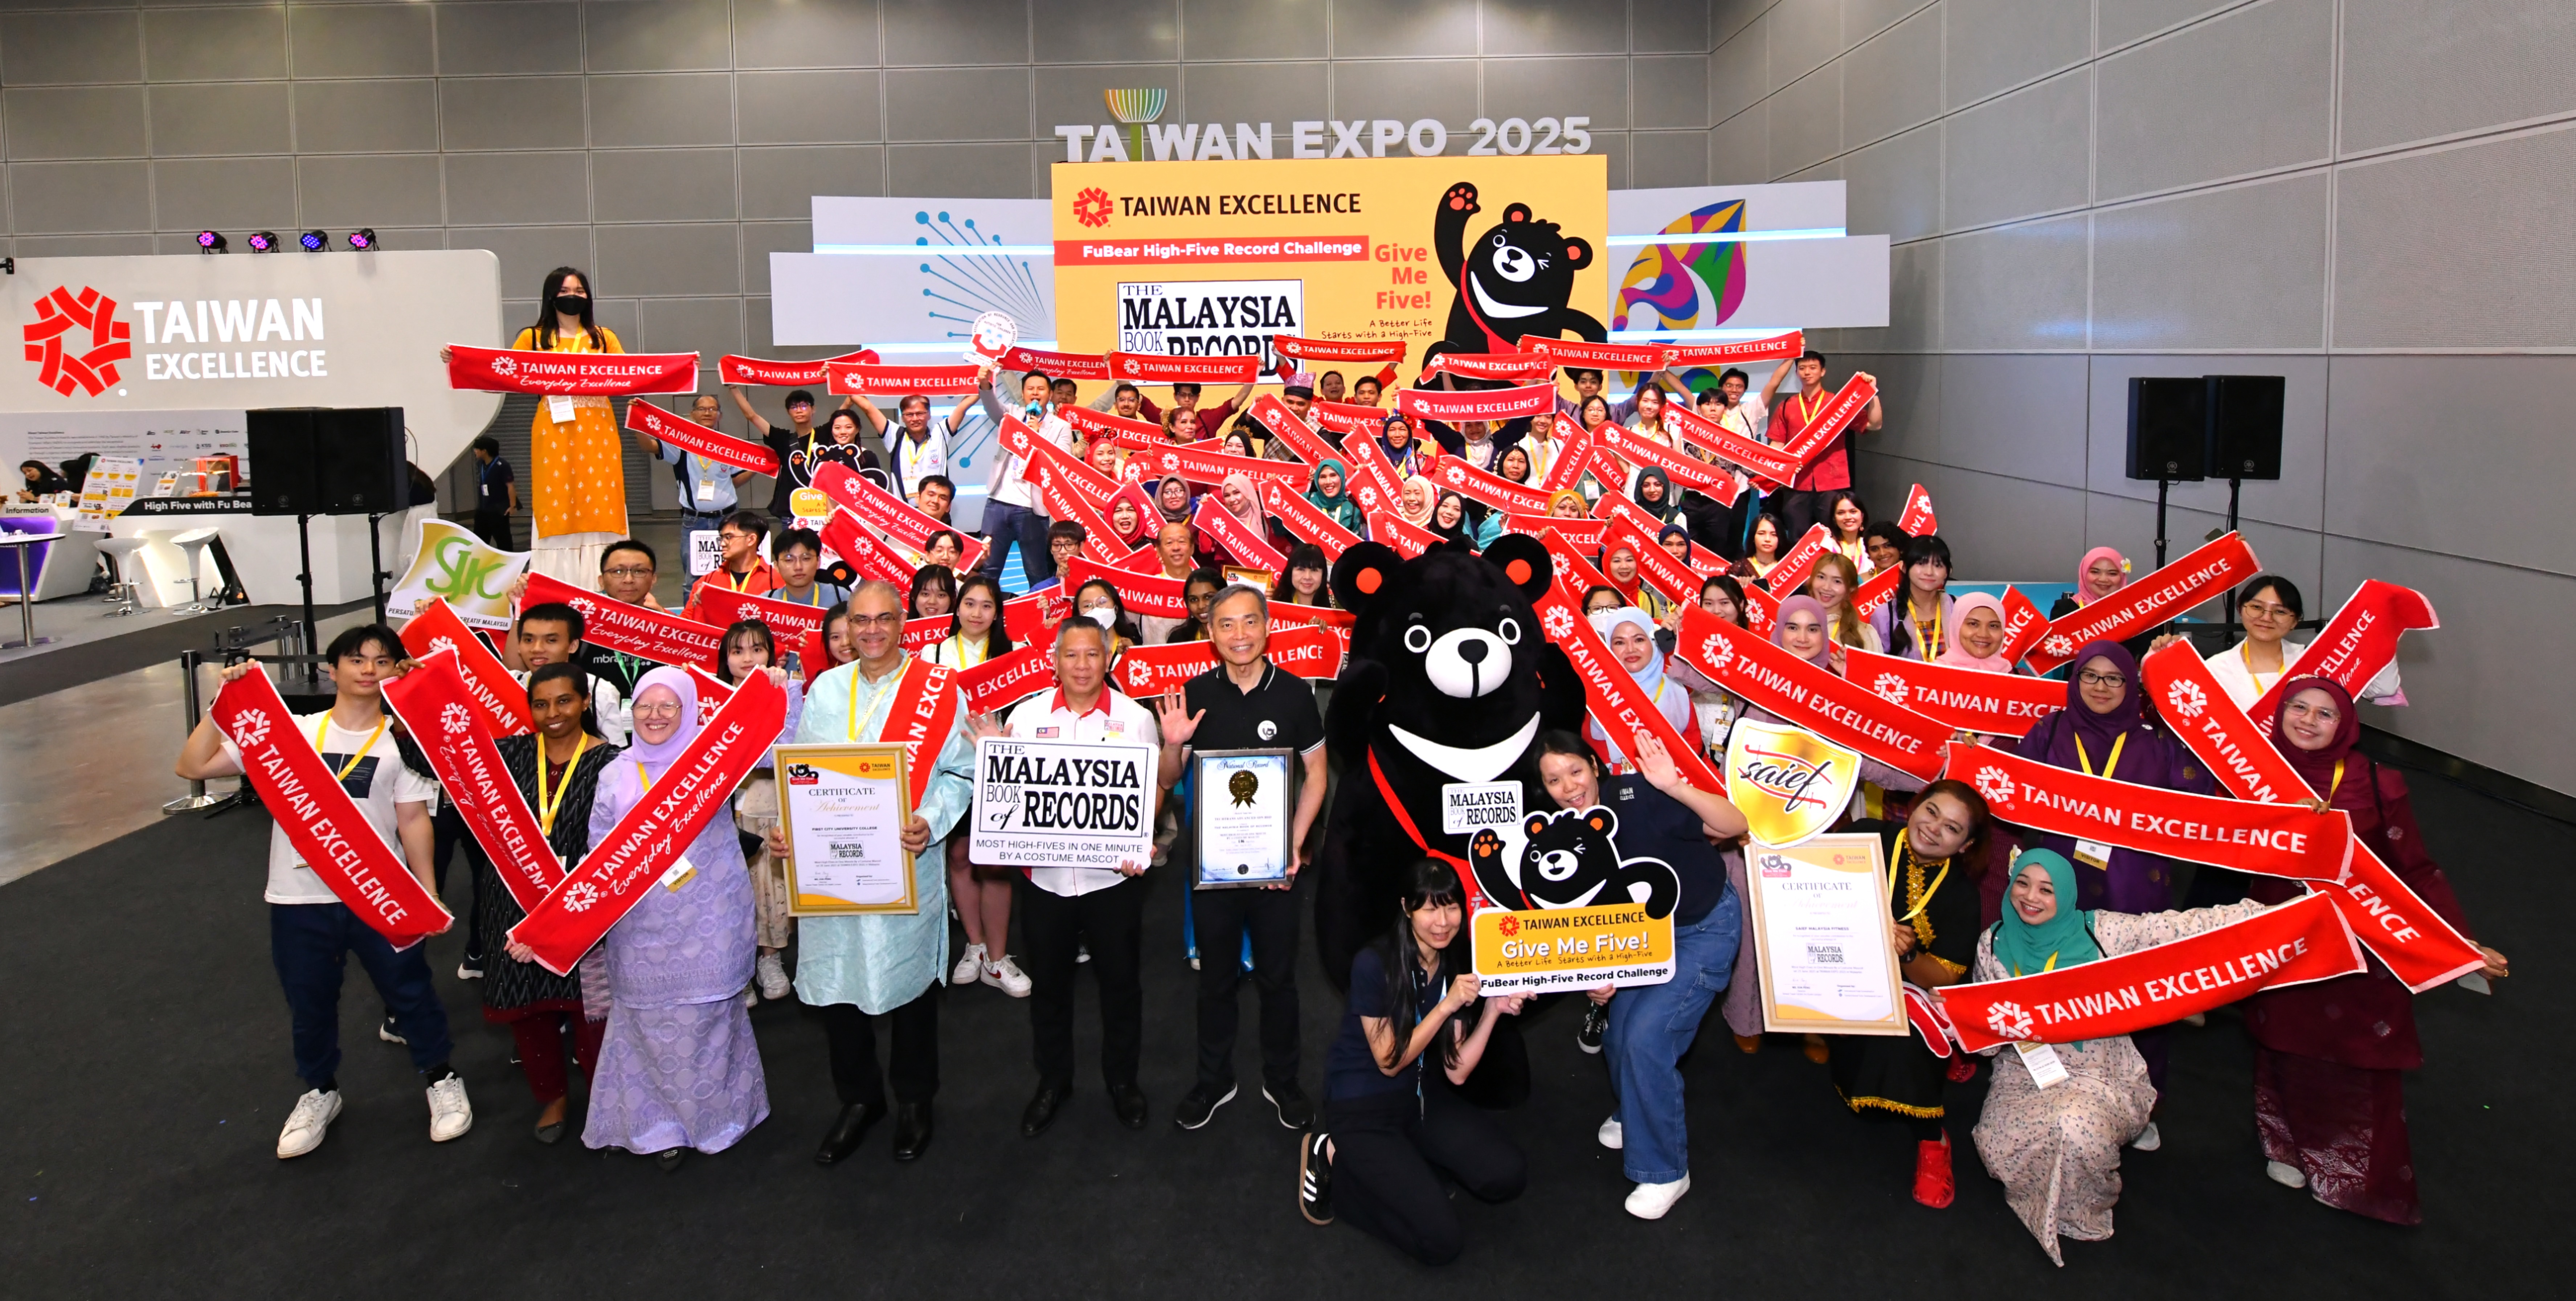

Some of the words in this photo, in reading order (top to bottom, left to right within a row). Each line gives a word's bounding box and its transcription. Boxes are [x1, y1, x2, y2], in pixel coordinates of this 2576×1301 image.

[1055, 122, 1273, 162] TAIWAN
[1292, 119, 1447, 158] EXPO
[1468, 116, 1592, 155] 2025
[1120, 196, 1211, 217] TAIWAN
[1219, 193, 1361, 215] EXCELLENCE
[1083, 244, 1140, 259] FuBear
[1144, 243, 1219, 258] High-Five
[1224, 242, 1279, 256] Record
[1284, 240, 1362, 258] Challenge
[1374, 244, 1427, 263] Give
[1392, 267, 1427, 285] Me
[1122, 285, 1162, 296] THE
[1376, 291, 1431, 310] Five!
[133, 298, 324, 344] TAIWAN
[1124, 296, 1295, 330] MALAYSIA
[1125, 332, 1163, 352] BOOK
[1303, 345, 1338, 355] TAIWAN
[1682, 345, 1722, 357] TAIWAN
[1724, 340, 1787, 354] EXCELLENCE
[146, 349, 327, 380] EXCELLENCE
[1035, 357, 1064, 366] TAIWAN
[1448, 357, 1486, 369] TAIWAN
[1488, 361, 1548, 372] EXCELLENCE
[1551, 348, 1592, 361] TAIWAN
[1593, 351, 1652, 363] EXCELLENCE
[522, 363, 576, 375] TAIWAN
[581, 365, 662, 375] EXCELLENCE
[757, 370, 800, 379] TAIWAN
[1143, 363, 1181, 373] TAIWAN
[1185, 365, 1243, 374] EXCELLENCE
[867, 378, 910, 386] TAIWAN
[914, 377, 979, 386] EXCELLENCE
[1433, 403, 1474, 413] TAIWAN
[1477, 397, 1540, 412] EXCELLENCE
[1814, 391, 1860, 442] EXCELLENCE
[664, 425, 703, 448] TAIWAN
[706, 442, 766, 466] EXCELLENCE
[1684, 418, 1720, 443] TAIWAN
[1723, 441, 1786, 471] EXCELLENCE
[1182, 461, 1224, 475] TAIWAN
[1622, 438, 1666, 462] TAIWAN
[1668, 461, 1725, 490] EXCELLENCE
[1468, 477, 1509, 500] TAIWAN
[145, 501, 168, 511] High
[171, 501, 192, 510] Five
[195, 500, 216, 509] with
[218, 500, 230, 509] Fu
[233, 500, 252, 508] Bea
[862, 490, 897, 516] TAIWAN
[1281, 500, 1316, 535] TAIWAN
[873, 551, 911, 584] TAIWAN
[1641, 553, 1682, 590] TAIWAN
[2072, 607, 2134, 642] TAIWAN
[2135, 558, 2231, 615] EXCELLENCE
[600, 609, 657, 635] TAIWAN
[1568, 637, 1622, 707] TAIWAN
[461, 664, 517, 729] TAIWAN
[1736, 655, 1808, 703] TAIWAN
[1809, 694, 1922, 754] EXCELLENCE
[1915, 686, 1999, 714] TAIWAN
[989, 744, 1025, 754] THE
[1217, 760, 1245, 770] National
[1246, 760, 1269, 769] Record
[2207, 716, 2278, 803] TAIWAN
[460, 735, 502, 810] TAIWAN
[987, 756, 1140, 788] MALAYSIA
[986, 785, 1021, 803] BOOK
[1741, 760, 1831, 813] saief
[592, 819, 658, 881] TAIWAN
[653, 721, 744, 822] EXCELLENCE
[810, 800, 880, 812] Achievement
[1450, 791, 1515, 806] MALAYSIA
[990, 805, 1019, 830] of
[1023, 791, 1139, 831] RECORDS
[1451, 807, 1465, 815] BOOK
[1467, 806, 1516, 825] RECORDS
[2021, 783, 2121, 826] TAIWAN
[2130, 813, 2307, 854] EXCELLENCE
[258, 742, 321, 822] TAIWAN
[309, 817, 408, 926] EXCELLENCE
[976, 839, 1006, 848] MOST
[1008, 840, 1065, 850] HIGH-FIVES
[1081, 843, 1102, 851] ONE
[1105, 843, 1143, 853] MINUTE
[1025, 853, 1074, 862] COSTUME
[1077, 854, 1119, 863] MASCOT
[2081, 853, 2099, 863] VISITOR
[673, 872, 689, 885] VISITOR
[1524, 916, 1570, 930] TAIWAN
[1574, 912, 1645, 926] EXCELLENCE
[1502, 940, 1551, 958] Give
[1558, 937, 1588, 955] Me
[1596, 932, 1649, 952] Five!
[1505, 959, 1532, 967] Better
[1616, 950, 1652, 960] High-Five
[1817, 954, 1843, 962] RECORDS
[1481, 978, 1518, 988] FuBear
[1522, 974, 1574, 986] High-Five
[1577, 971, 1614, 982] Record
[1617, 967, 1668, 979] Challenge
[2034, 986, 2140, 1025] TAIWAN
[2147, 937, 2308, 1003] EXCELLENCE
